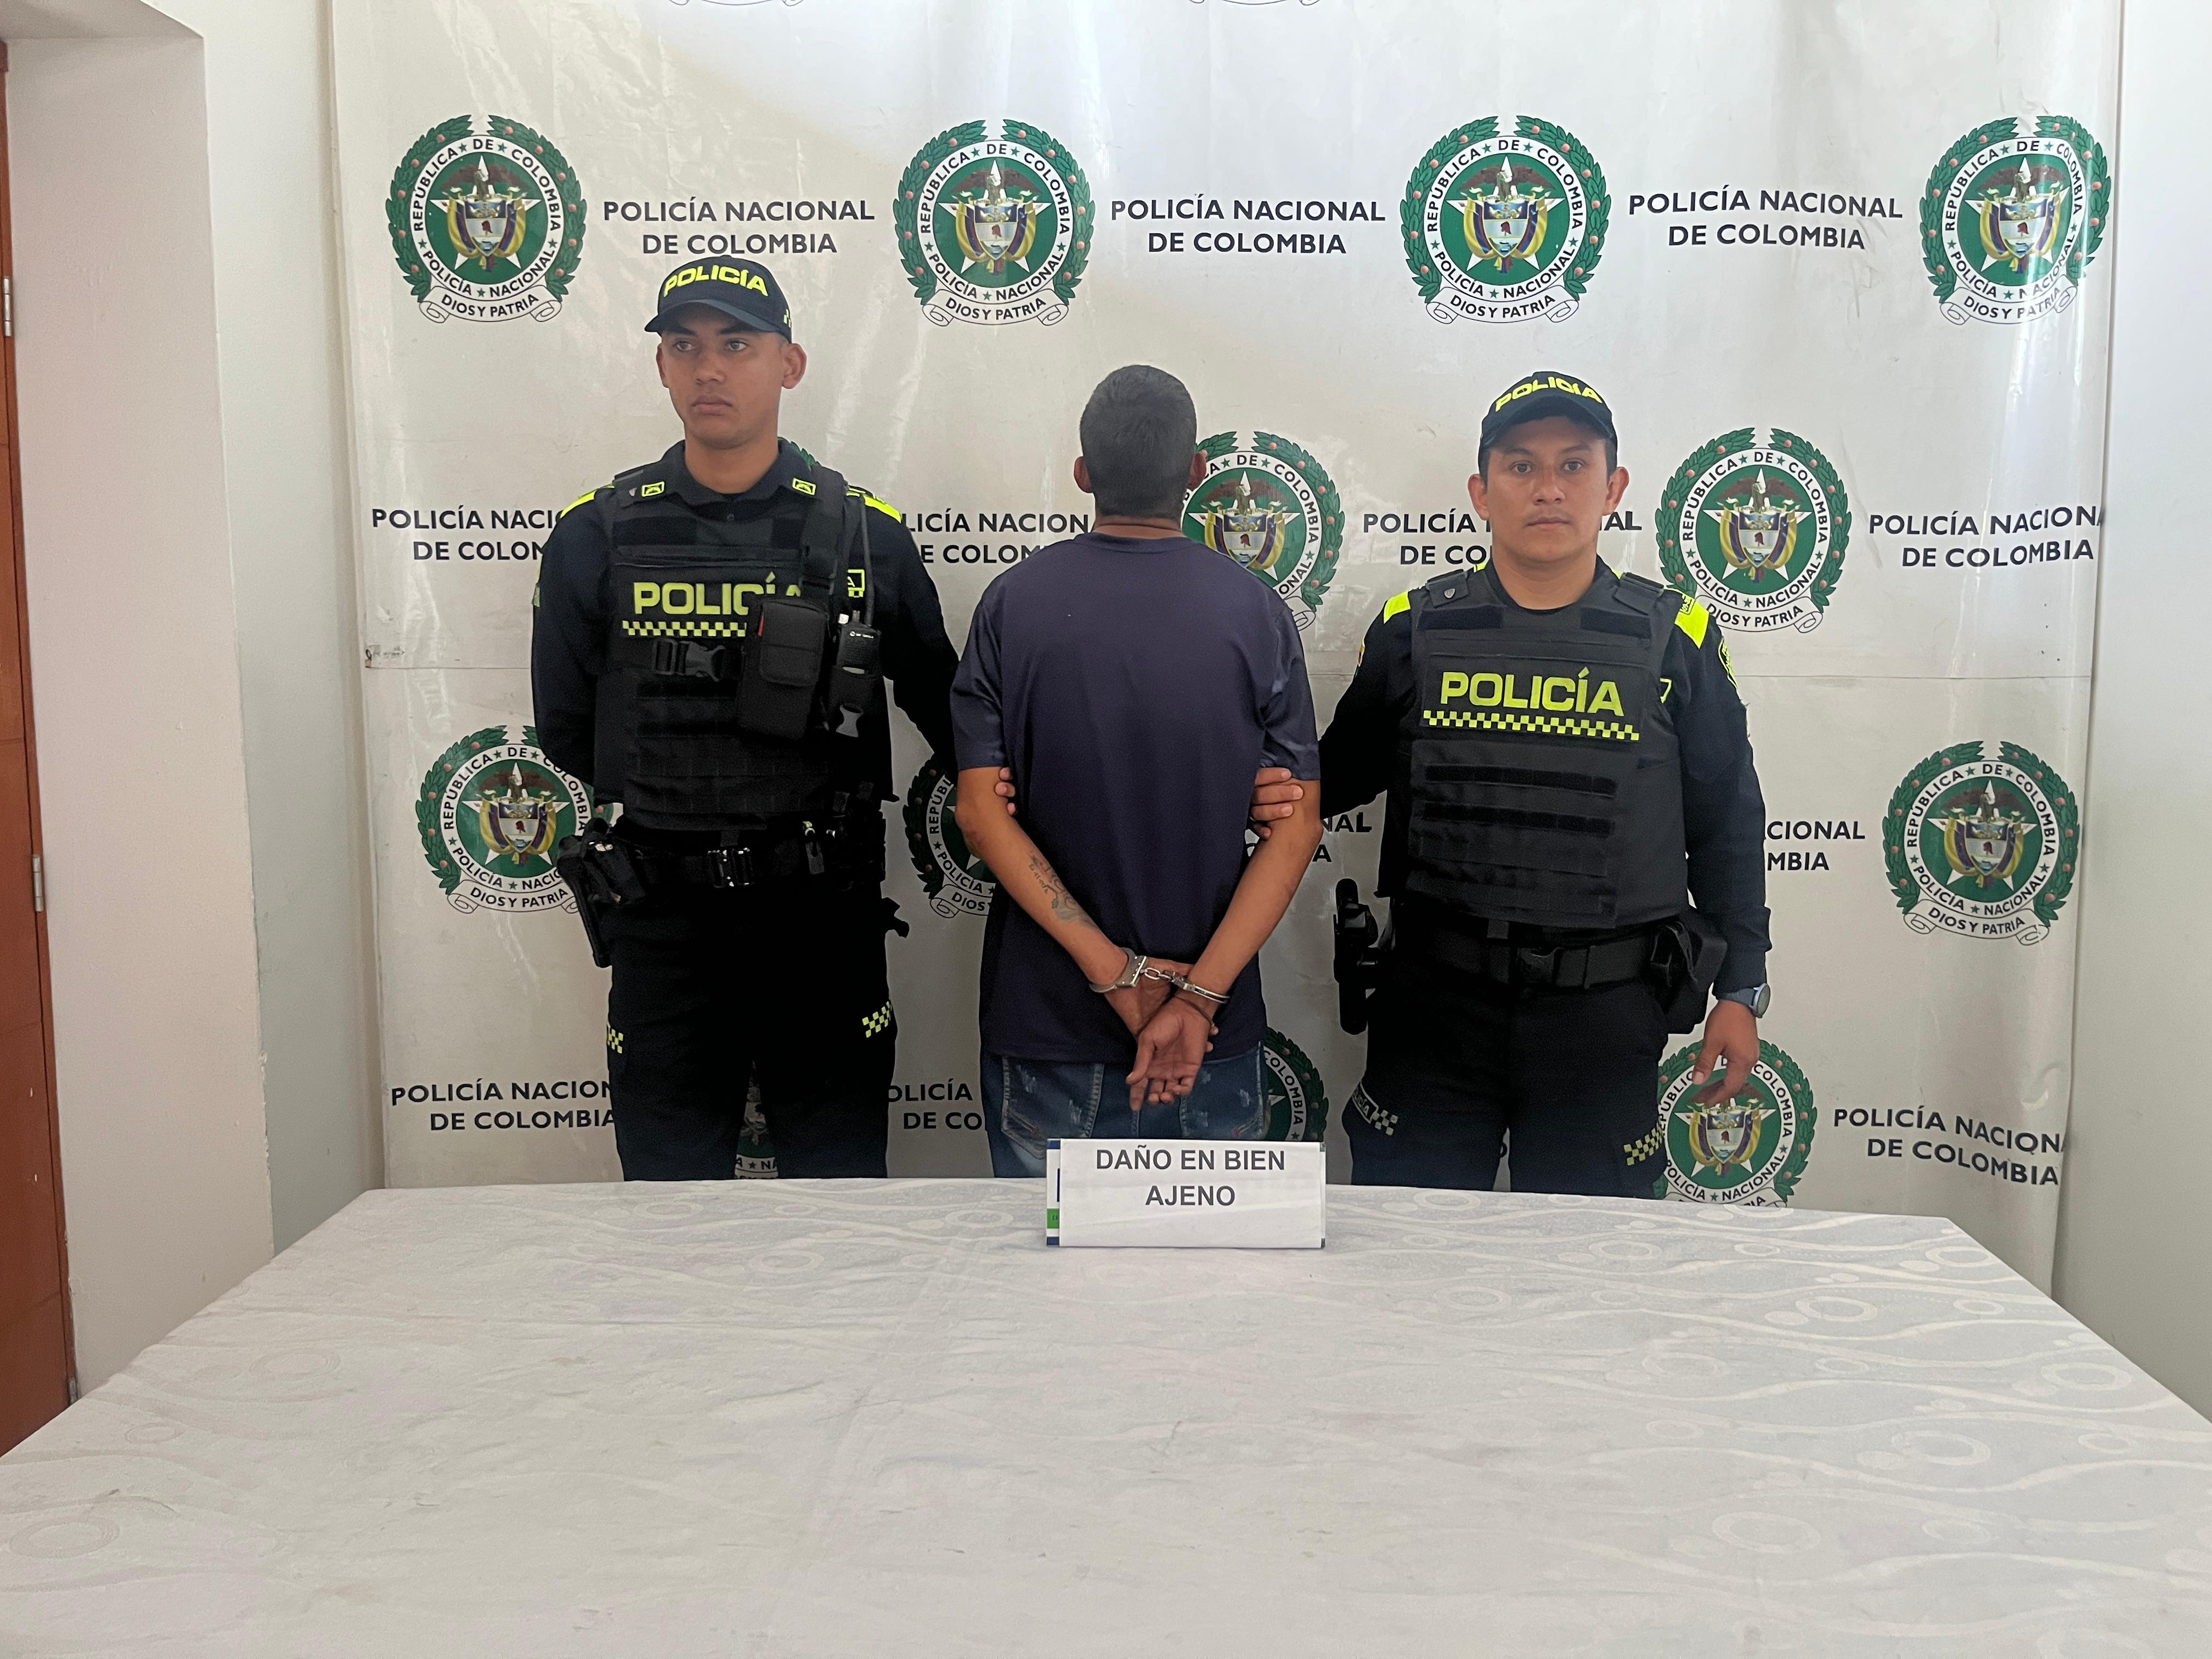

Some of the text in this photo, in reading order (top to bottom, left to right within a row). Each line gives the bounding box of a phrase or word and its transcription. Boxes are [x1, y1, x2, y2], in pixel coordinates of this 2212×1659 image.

[473, 139, 493, 150] DE
[512, 149, 560, 231] COLOMBIA
[988, 144, 1007, 154] DE
[1024, 153, 1070, 234] COLOMBIA
[1498, 140, 1520, 151] DE
[1537, 148, 1583, 229] COLOMBIA
[2017, 140, 2040, 151] DE
[2057, 143, 2082, 215] COLOMBIA
[604, 197, 874, 221] POLICÍA NACIONAL
[1112, 194, 1385, 221] POLICÍA NACIONAL
[1630, 185, 1903, 218] POLICÍA NACIONAL
[643, 234, 837, 253] DE COLOMBIA
[1149, 233, 1346, 253] DE COLOMBIA
[1669, 224, 1865, 249] DE COLOMBIA
[423, 250, 556, 297] POLICÍA NACIONAL
[929, 253, 1063, 300] POLICÍA NACIONAL
[1435, 249, 1575, 298] POLICÍA NACIONAL
[1951, 251, 1996, 297] POLICÍA
[490, 294, 539, 317] PATRIA
[996, 297, 1046, 320] PATRIA
[1503, 295, 1555, 318] PATRIA
[2017, 287, 2061, 318] PATRIA
[1237, 455, 1318, 543] DE COLOMBIA
[1754, 452, 1773, 463] DE
[1789, 462, 1827, 543] COLOMBIA
[372, 505, 562, 529] POLICÍA NACI
[904, 508, 1088, 533] LICÍA NACION
[1364, 509, 1476, 533] POLICÍA
[1870, 506, 2101, 535] POLICÍA NACION
[414, 541, 543, 560] DE COLOM
[921, 545, 1041, 563] E COLOM
[1401, 546, 1435, 565] DE
[1903, 540, 2094, 567] DE COLOMBIA
[1279, 561, 1312, 594] ONAL
[1690, 562, 1737, 606] POLICÍA
[1756, 561, 1820, 608] NACIONAL
[1755, 606, 1803, 627] PATRIA
[1440, 667, 1624, 716] POLICÍA
[508, 747, 527, 757] DE
[1983, 764, 2003, 775] DE
[2016, 774, 2055, 856] COLOMBIA
[1767, 821, 1865, 839] CIONAL
[453, 849, 503, 888] POLICÍA
[1768, 853, 1829, 871] MBIA
[522, 889, 568, 907] PATRIA
[951, 892, 985, 911] DIOS
[1913, 867, 2046, 915] POLICÍA NACIONAL
[1983, 917, 2025, 934] PATRIA
[392, 1079, 611, 1105] POLICÍA NACIO
[889, 1079, 973, 1102] OLICÍA
[1754, 1064, 1792, 1137] COLOMBIA
[431, 1110, 615, 1130] DE COLOMBIA
[904, 1112, 936, 1129] DE
[1835, 1105, 2062, 1153] POLICÍA NACION
[1097, 1144, 1284, 1170] DAÑO EN BIEN
[1867, 1139, 2058, 1185] DE COLOMBIA
[1722, 1154, 1785, 1200] NACIONAL
[1146, 1186, 1235, 1206] AJENO
